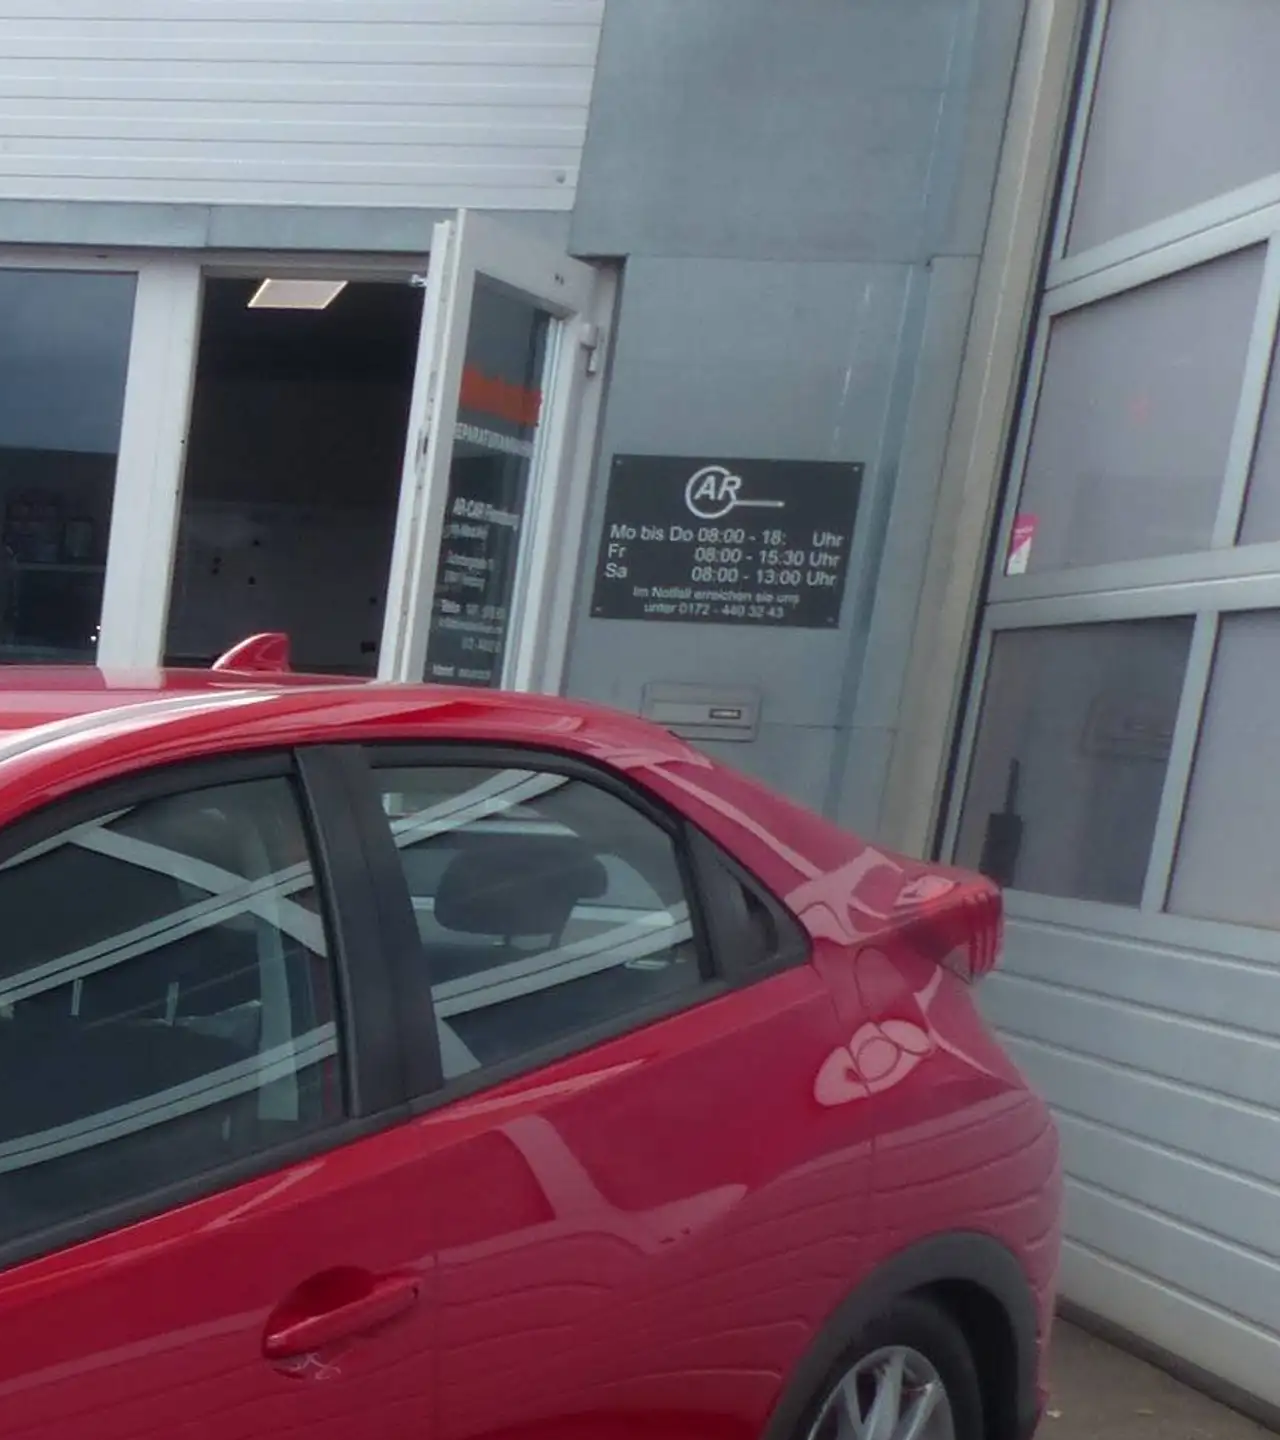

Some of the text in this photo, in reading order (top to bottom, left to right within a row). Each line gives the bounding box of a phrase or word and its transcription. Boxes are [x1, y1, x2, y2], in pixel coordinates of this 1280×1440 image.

[692, 474, 742, 501] AR
[610, 524, 636, 540] Mo
[640, 525, 664, 541] bis
[669, 526, 694, 541] Do
[698, 527, 745, 543] 08:00
[812, 531, 843, 548] Uhr
[608, 543, 626, 558] Fr
[694, 547, 742, 563] 08:00
[809, 551, 840, 567] Uhr
[605, 562, 627, 578] Sa
[691, 566, 738, 583] 08:00
[757, 569, 801, 586] 13:00
[806, 570, 837, 586] Uhr
[678, 602, 711, 616] 0172
